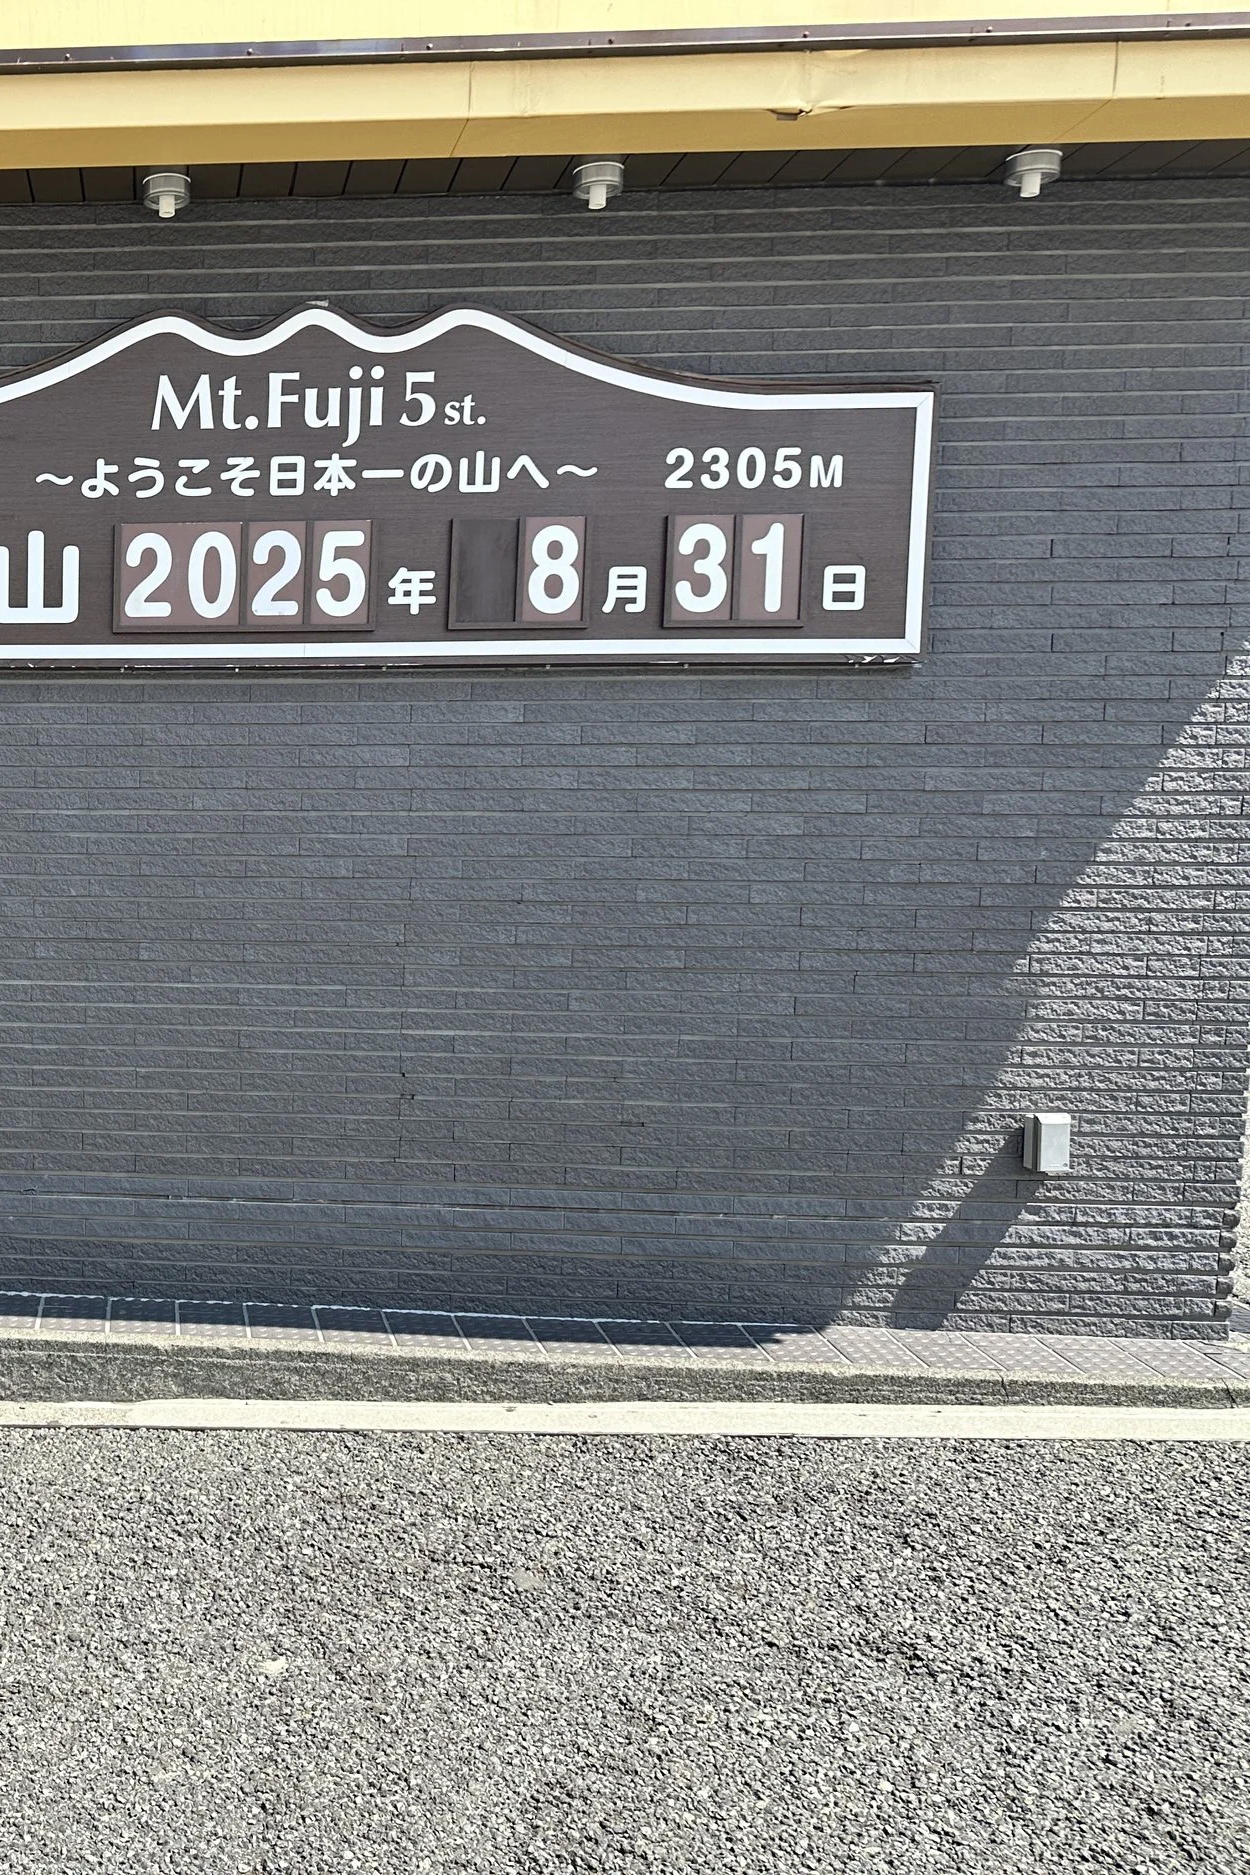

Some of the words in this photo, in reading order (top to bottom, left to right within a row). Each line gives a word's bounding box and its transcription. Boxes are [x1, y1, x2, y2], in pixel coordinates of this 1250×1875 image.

[664, 446, 844, 490] 2305M
[123, 529, 367, 620] 2025
[387, 566, 438, 616] 年
[527, 523, 581, 615] 8
[601, 565, 648, 614] 月
[674, 521, 786, 614] 31
[821, 564, 867, 611] 日
